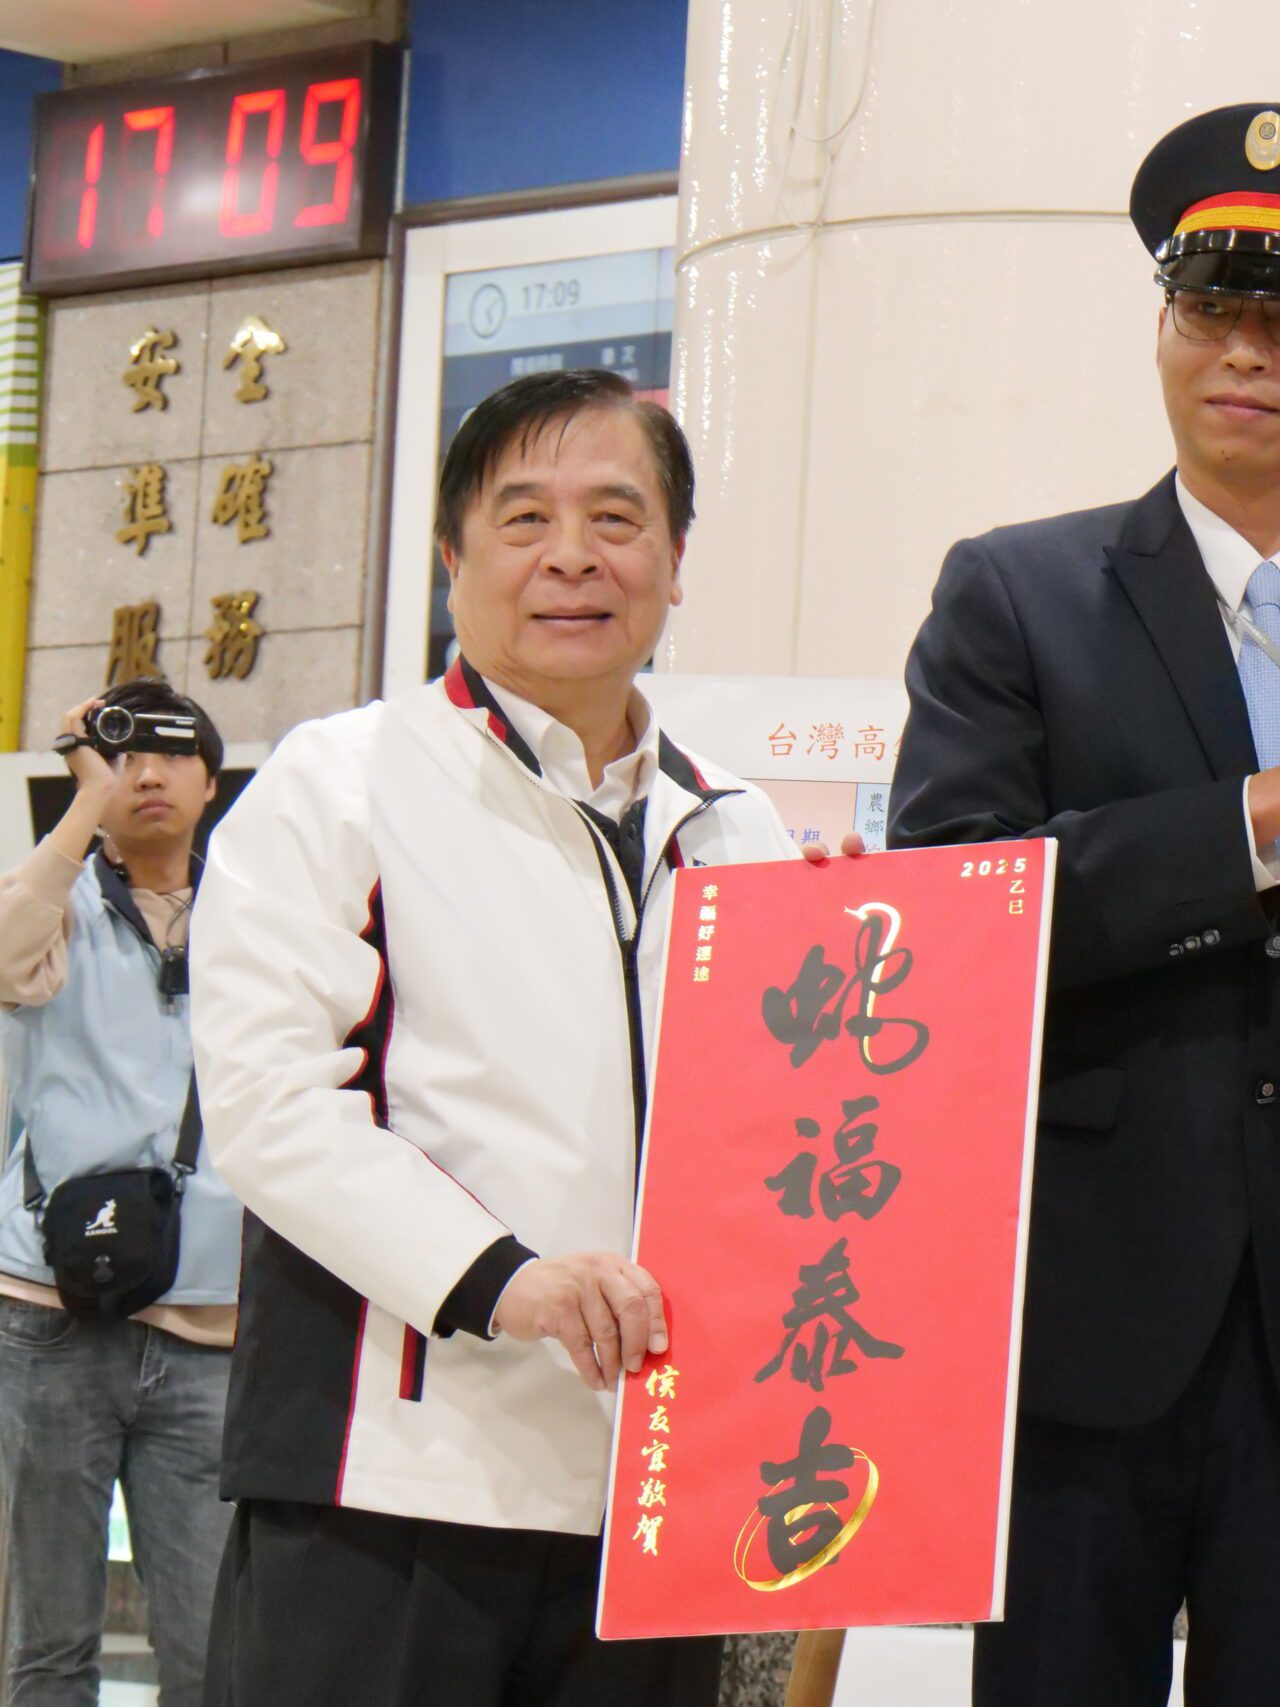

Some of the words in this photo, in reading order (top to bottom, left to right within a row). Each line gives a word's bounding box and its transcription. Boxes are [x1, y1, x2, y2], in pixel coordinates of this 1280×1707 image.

[218, 77, 361, 240] 09
[521, 279, 582, 311] 17:09
[767, 722, 902, 761] 台灣高
[960, 857, 1027, 878] 2025
[1008, 879, 1025, 915] 乙巳
[754, 903, 931, 1576] 蛇福泰吉
[632, 1364, 680, 1556] 侯友宜敬賀
